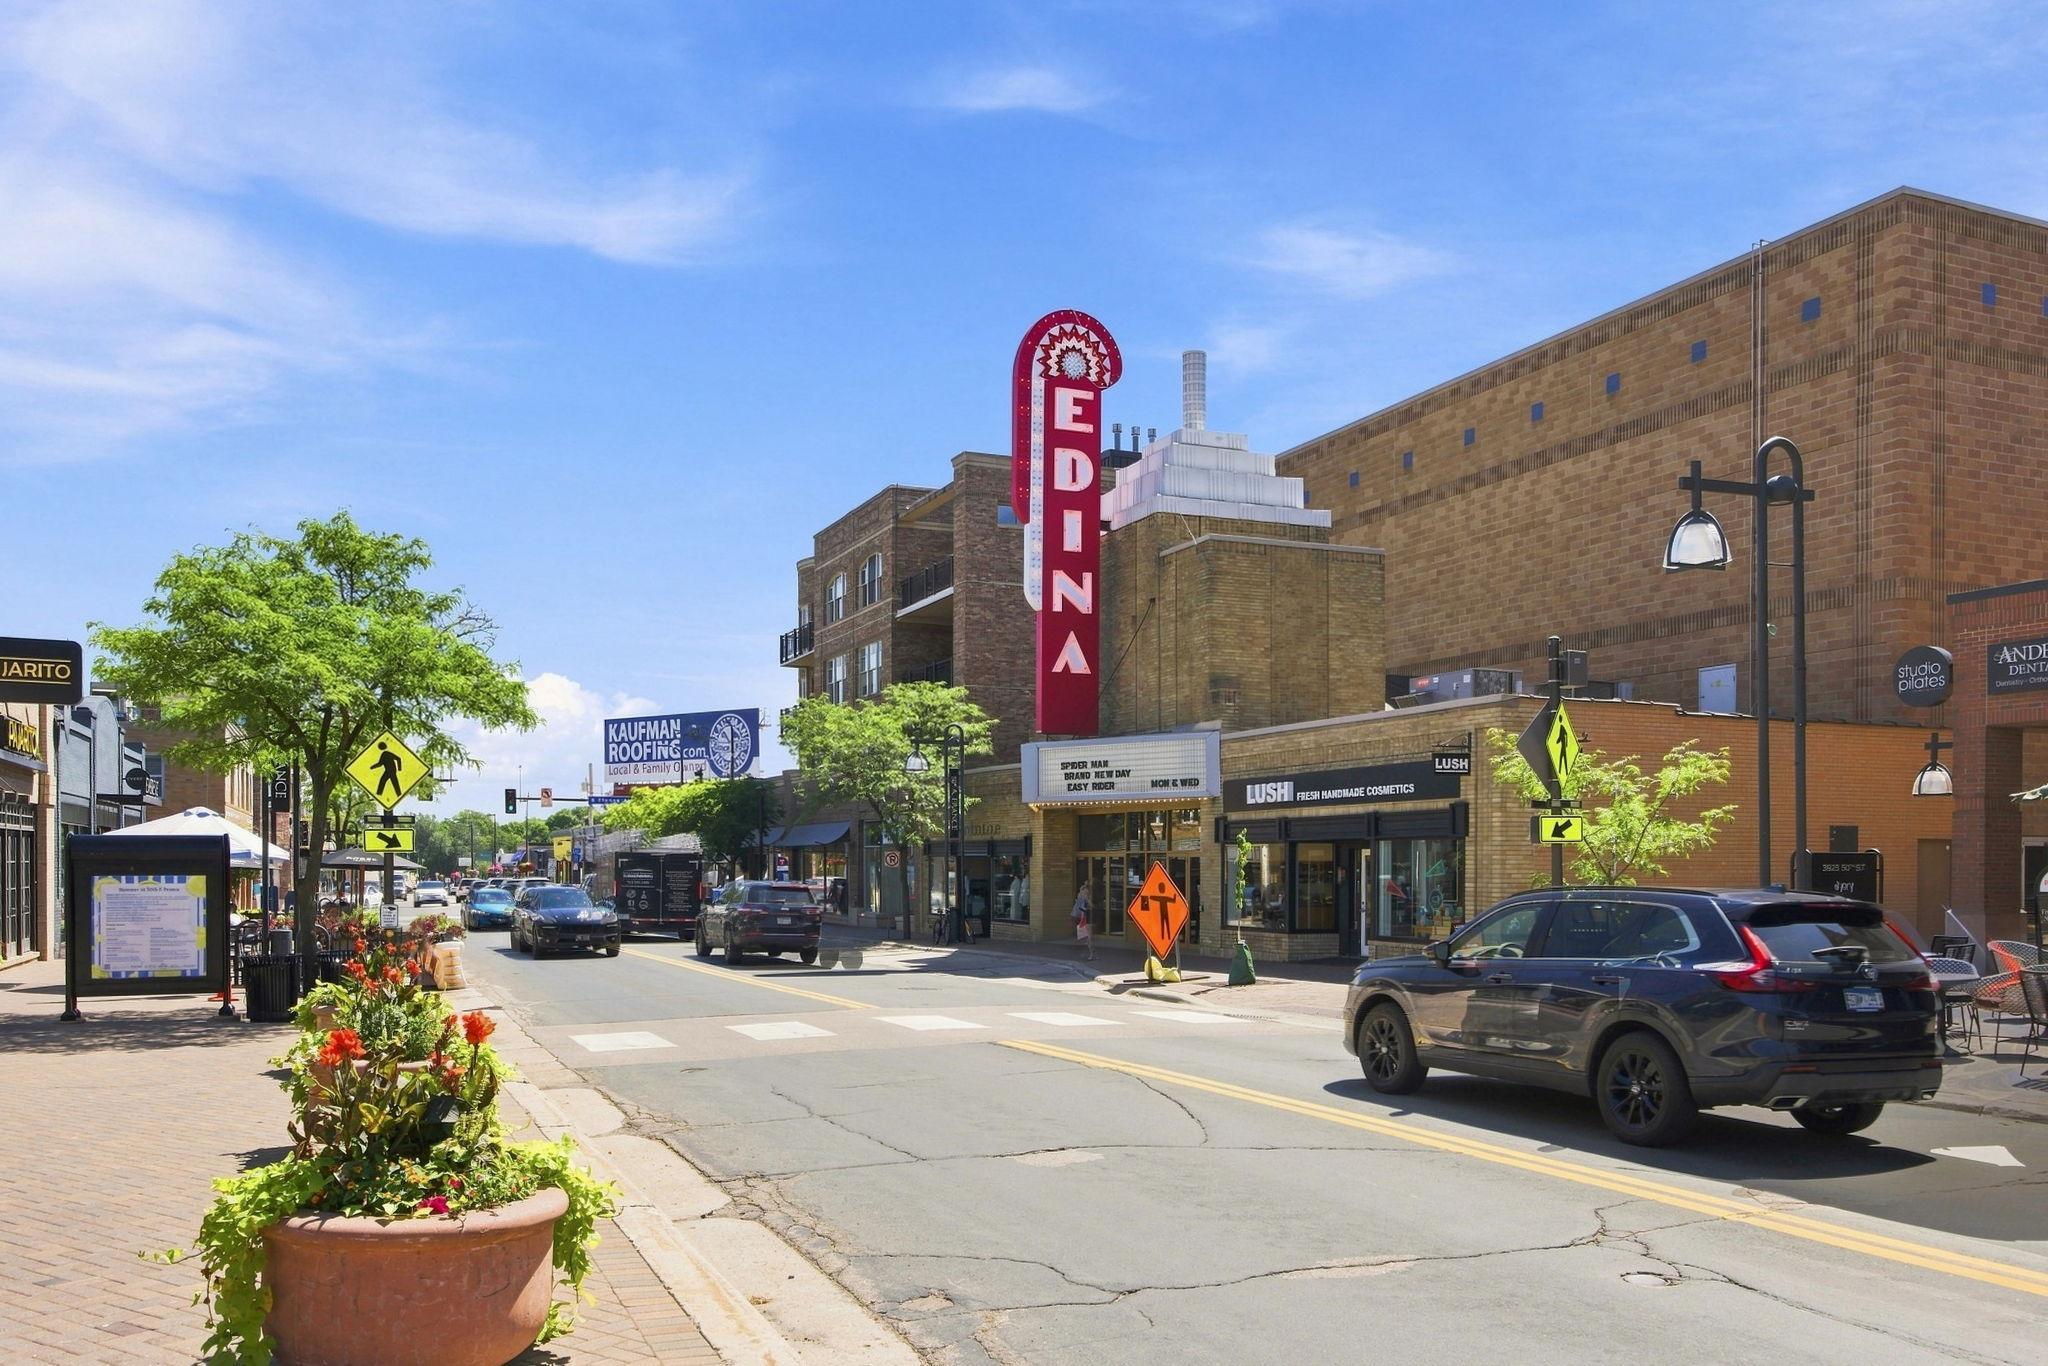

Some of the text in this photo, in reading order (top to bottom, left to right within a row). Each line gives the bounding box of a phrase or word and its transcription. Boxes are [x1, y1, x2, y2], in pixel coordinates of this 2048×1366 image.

[1052, 386, 1094, 675] EDINA
[1898, 661, 1941, 678] studio
[1898, 674, 1945, 695] pilates
[608, 718, 681, 743] KAUFMAN
[608, 739, 681, 763] ROOFING
[608, 763, 631, 775] Local
[633, 764, 640, 774] &
[642, 761, 671, 775] Family
[1060, 760, 1108, 770] SPIDER MAN
[1435, 758, 1468, 770] LUSH
[1064, 769, 1131, 780] BRAND NEW DAY
[1151, 779, 1169, 788] MON
[1180, 778, 1200, 787] WED
[1067, 782, 1115, 791] EASY RIDER
[1246, 781, 1294, 804] LUSH
[1297, 783, 1415, 801] FRESH HANDMADE COSMETICS
